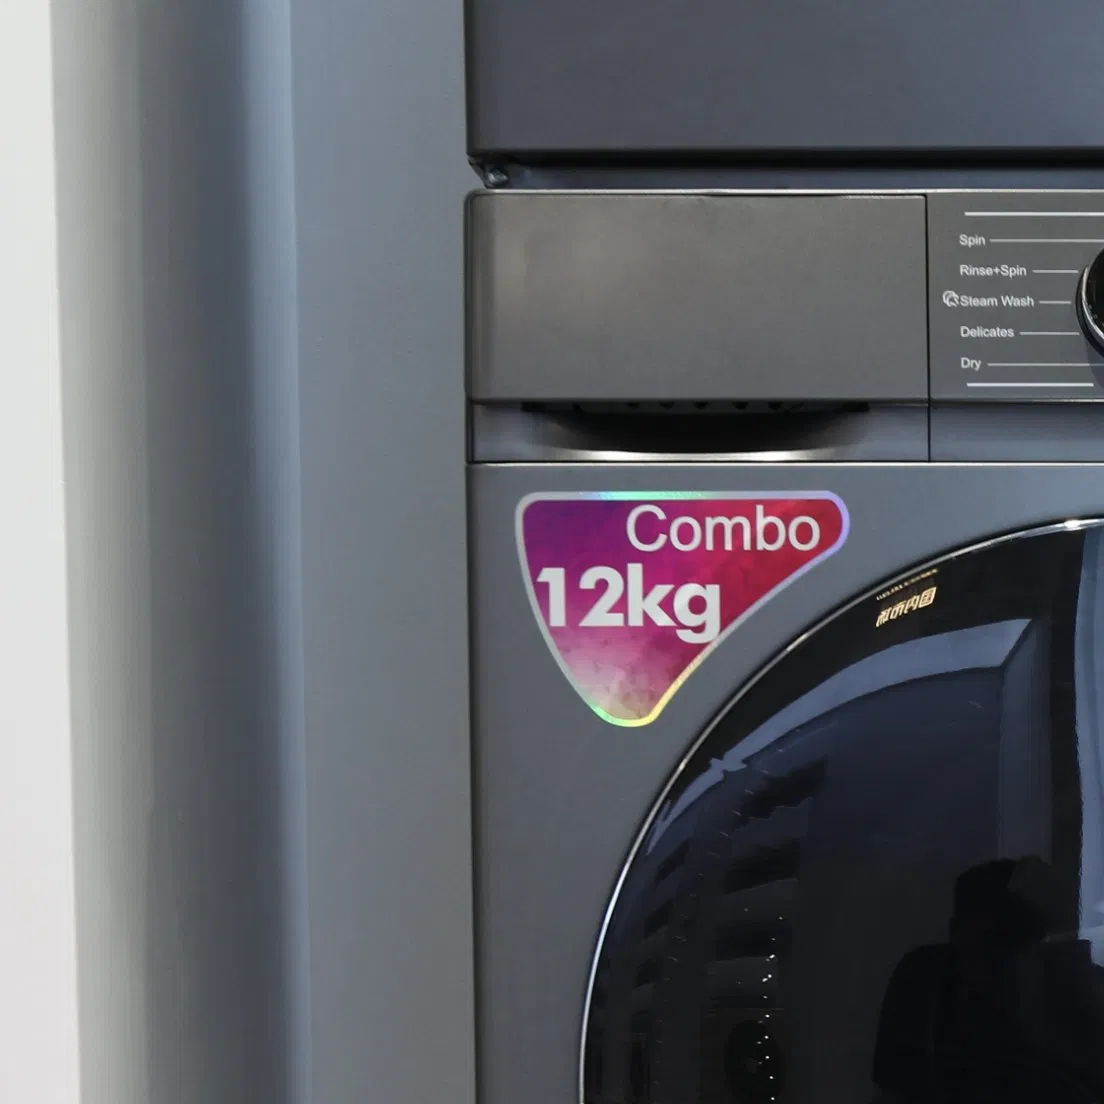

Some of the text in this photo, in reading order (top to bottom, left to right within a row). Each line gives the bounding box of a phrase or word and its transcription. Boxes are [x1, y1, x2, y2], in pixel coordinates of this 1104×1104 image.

[959, 233, 986, 248] Spin
[959, 264, 1027, 279] Rinse+Spin
[960, 295, 1034, 308] Steam Wash
[960, 326, 1015, 339] Delicates
[960, 357, 982, 371] Dry
[626, 504, 821, 552] Combo
[537, 563, 721, 644] 12kg
